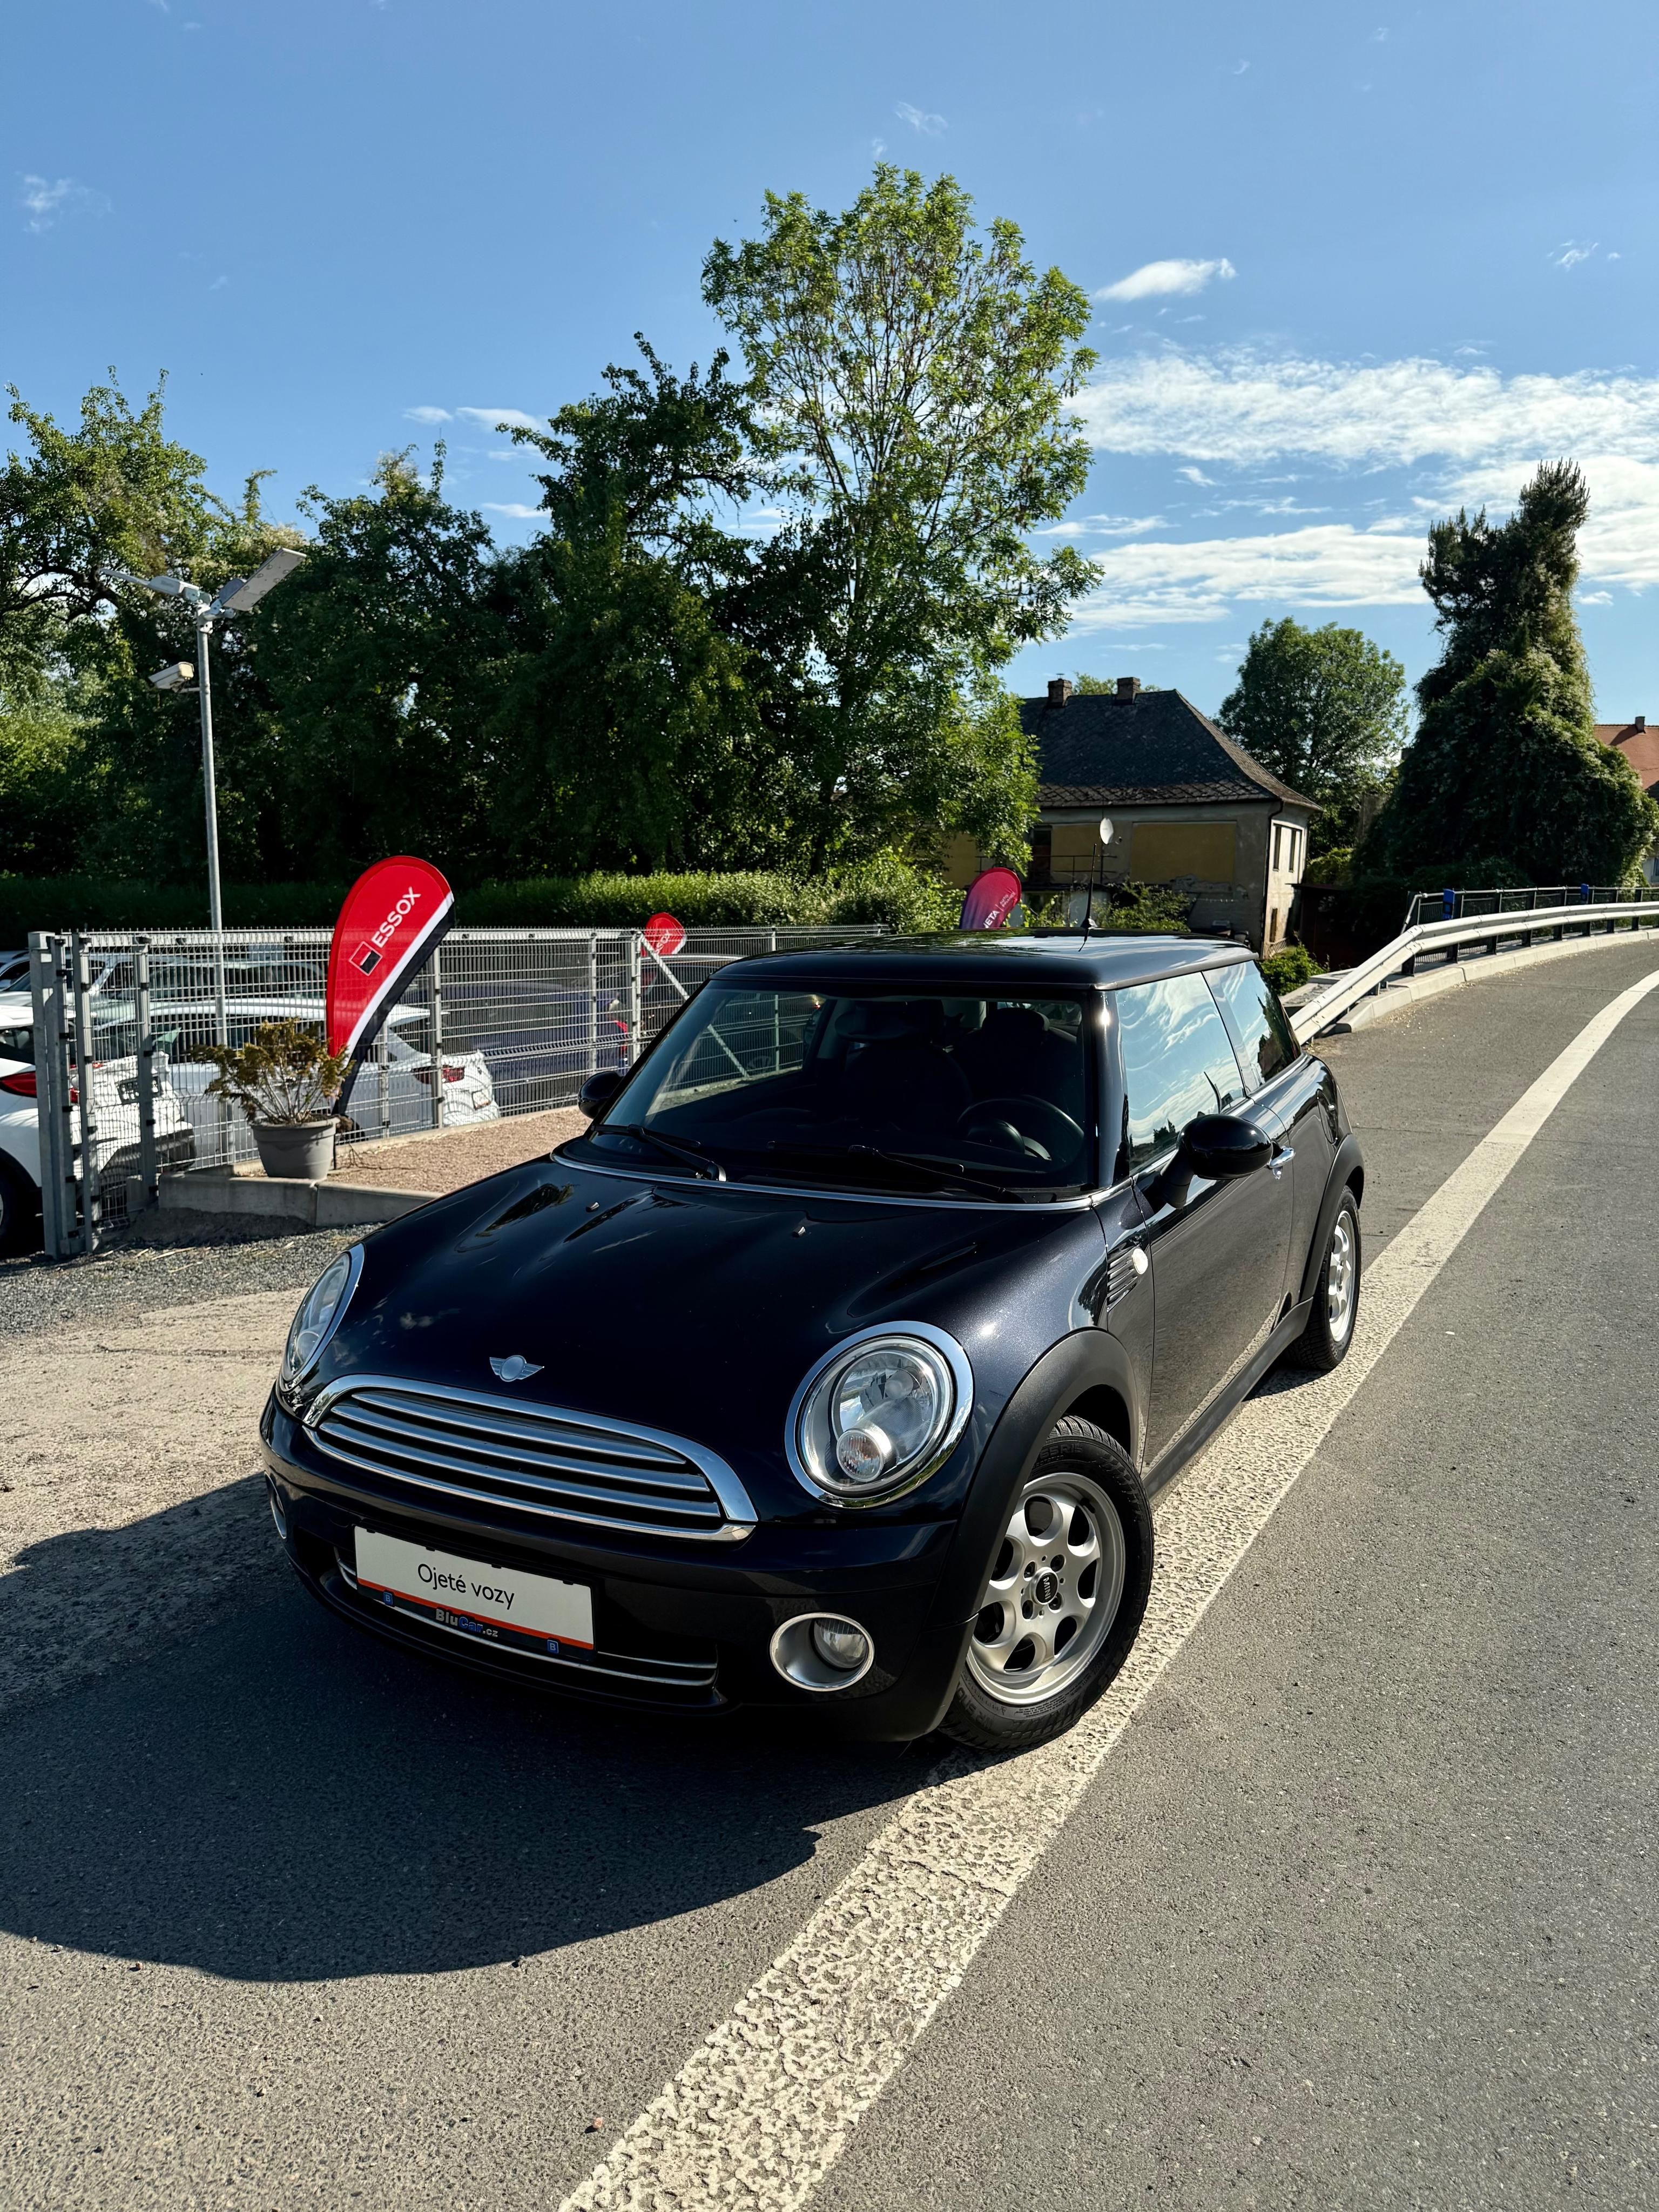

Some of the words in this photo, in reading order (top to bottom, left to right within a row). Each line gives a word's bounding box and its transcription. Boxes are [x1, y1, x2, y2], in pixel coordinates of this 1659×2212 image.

[372, 886, 421, 948] ESSOX
[417, 1563, 466, 1593] Ojeté
[471, 1582, 515, 1610] vozy
[1043, 1577, 1051, 1599] MINI
[436, 1609, 498, 1637] BluCar.cz
[550, 1642, 556, 1650] B
